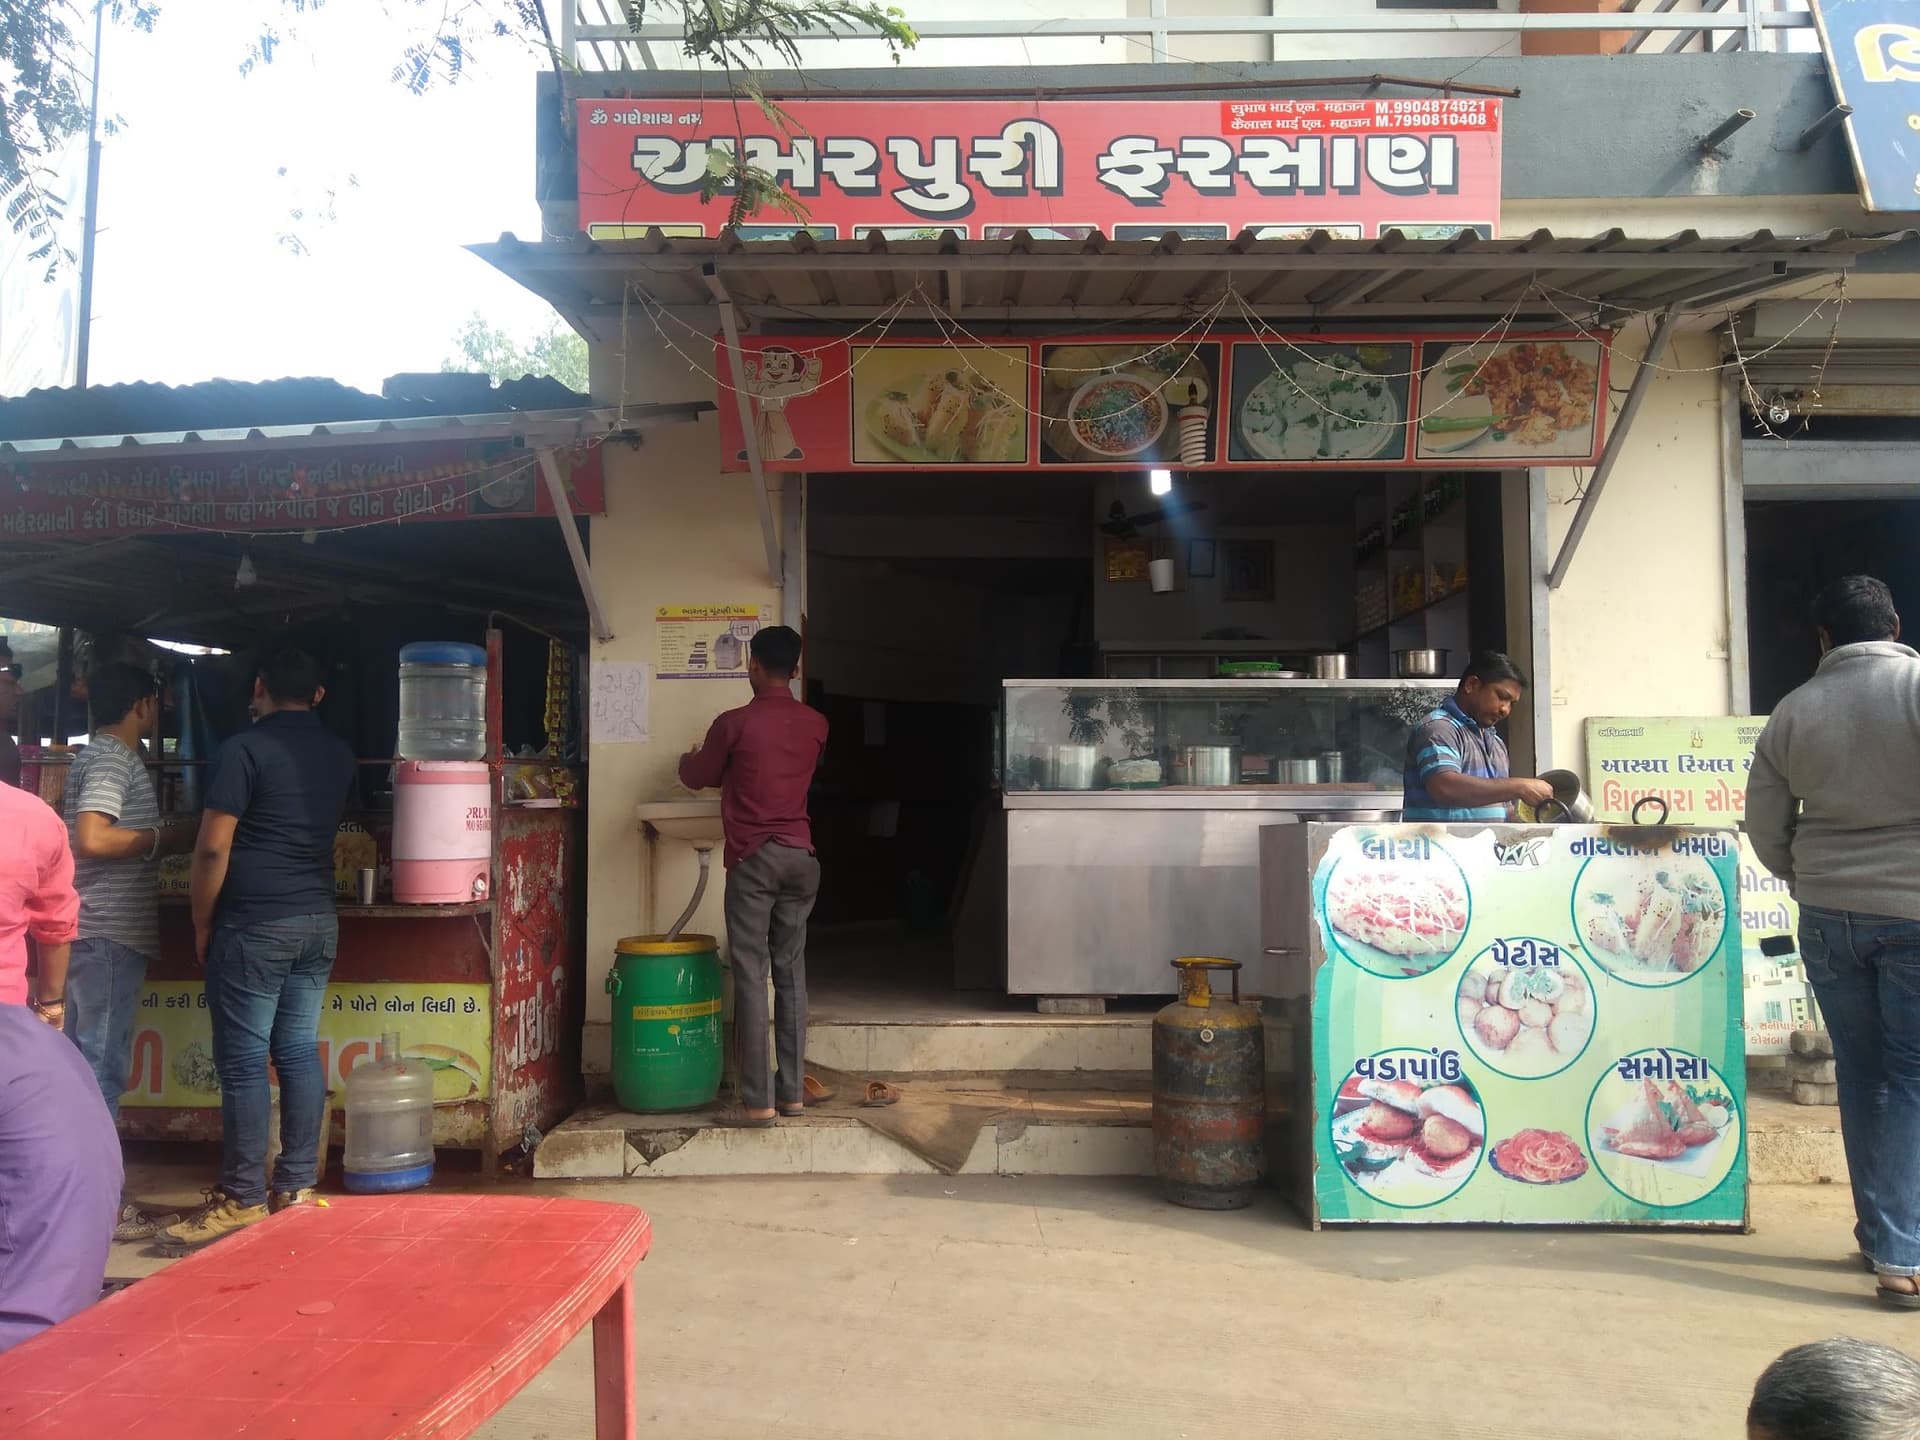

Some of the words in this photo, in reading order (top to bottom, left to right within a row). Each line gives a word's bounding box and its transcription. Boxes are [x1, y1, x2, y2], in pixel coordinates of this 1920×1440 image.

[613, 108, 673, 125] ગણેશાય
[1325, 102, 1366, 114] महाजन
[1330, 118, 1371, 130] महाजन
[1375, 113, 1487, 127] M.7990810408
[1097, 135, 1458, 205] ફરસાણ
[82, 503, 110, 530] કરી
[1601, 757, 1669, 774] આસ્થા
[1490, 937, 1560, 968] પેટીસ
[350, 994, 377, 1012] પોતે
[384, 995, 415, 1013] લોન
[421, 996, 456, 1014] લિધી
[463, 995, 481, 1014] છે.
[1354, 1046, 1461, 1082] વડાપાંઉ
[1617, 1047, 1709, 1081] સમોસા
